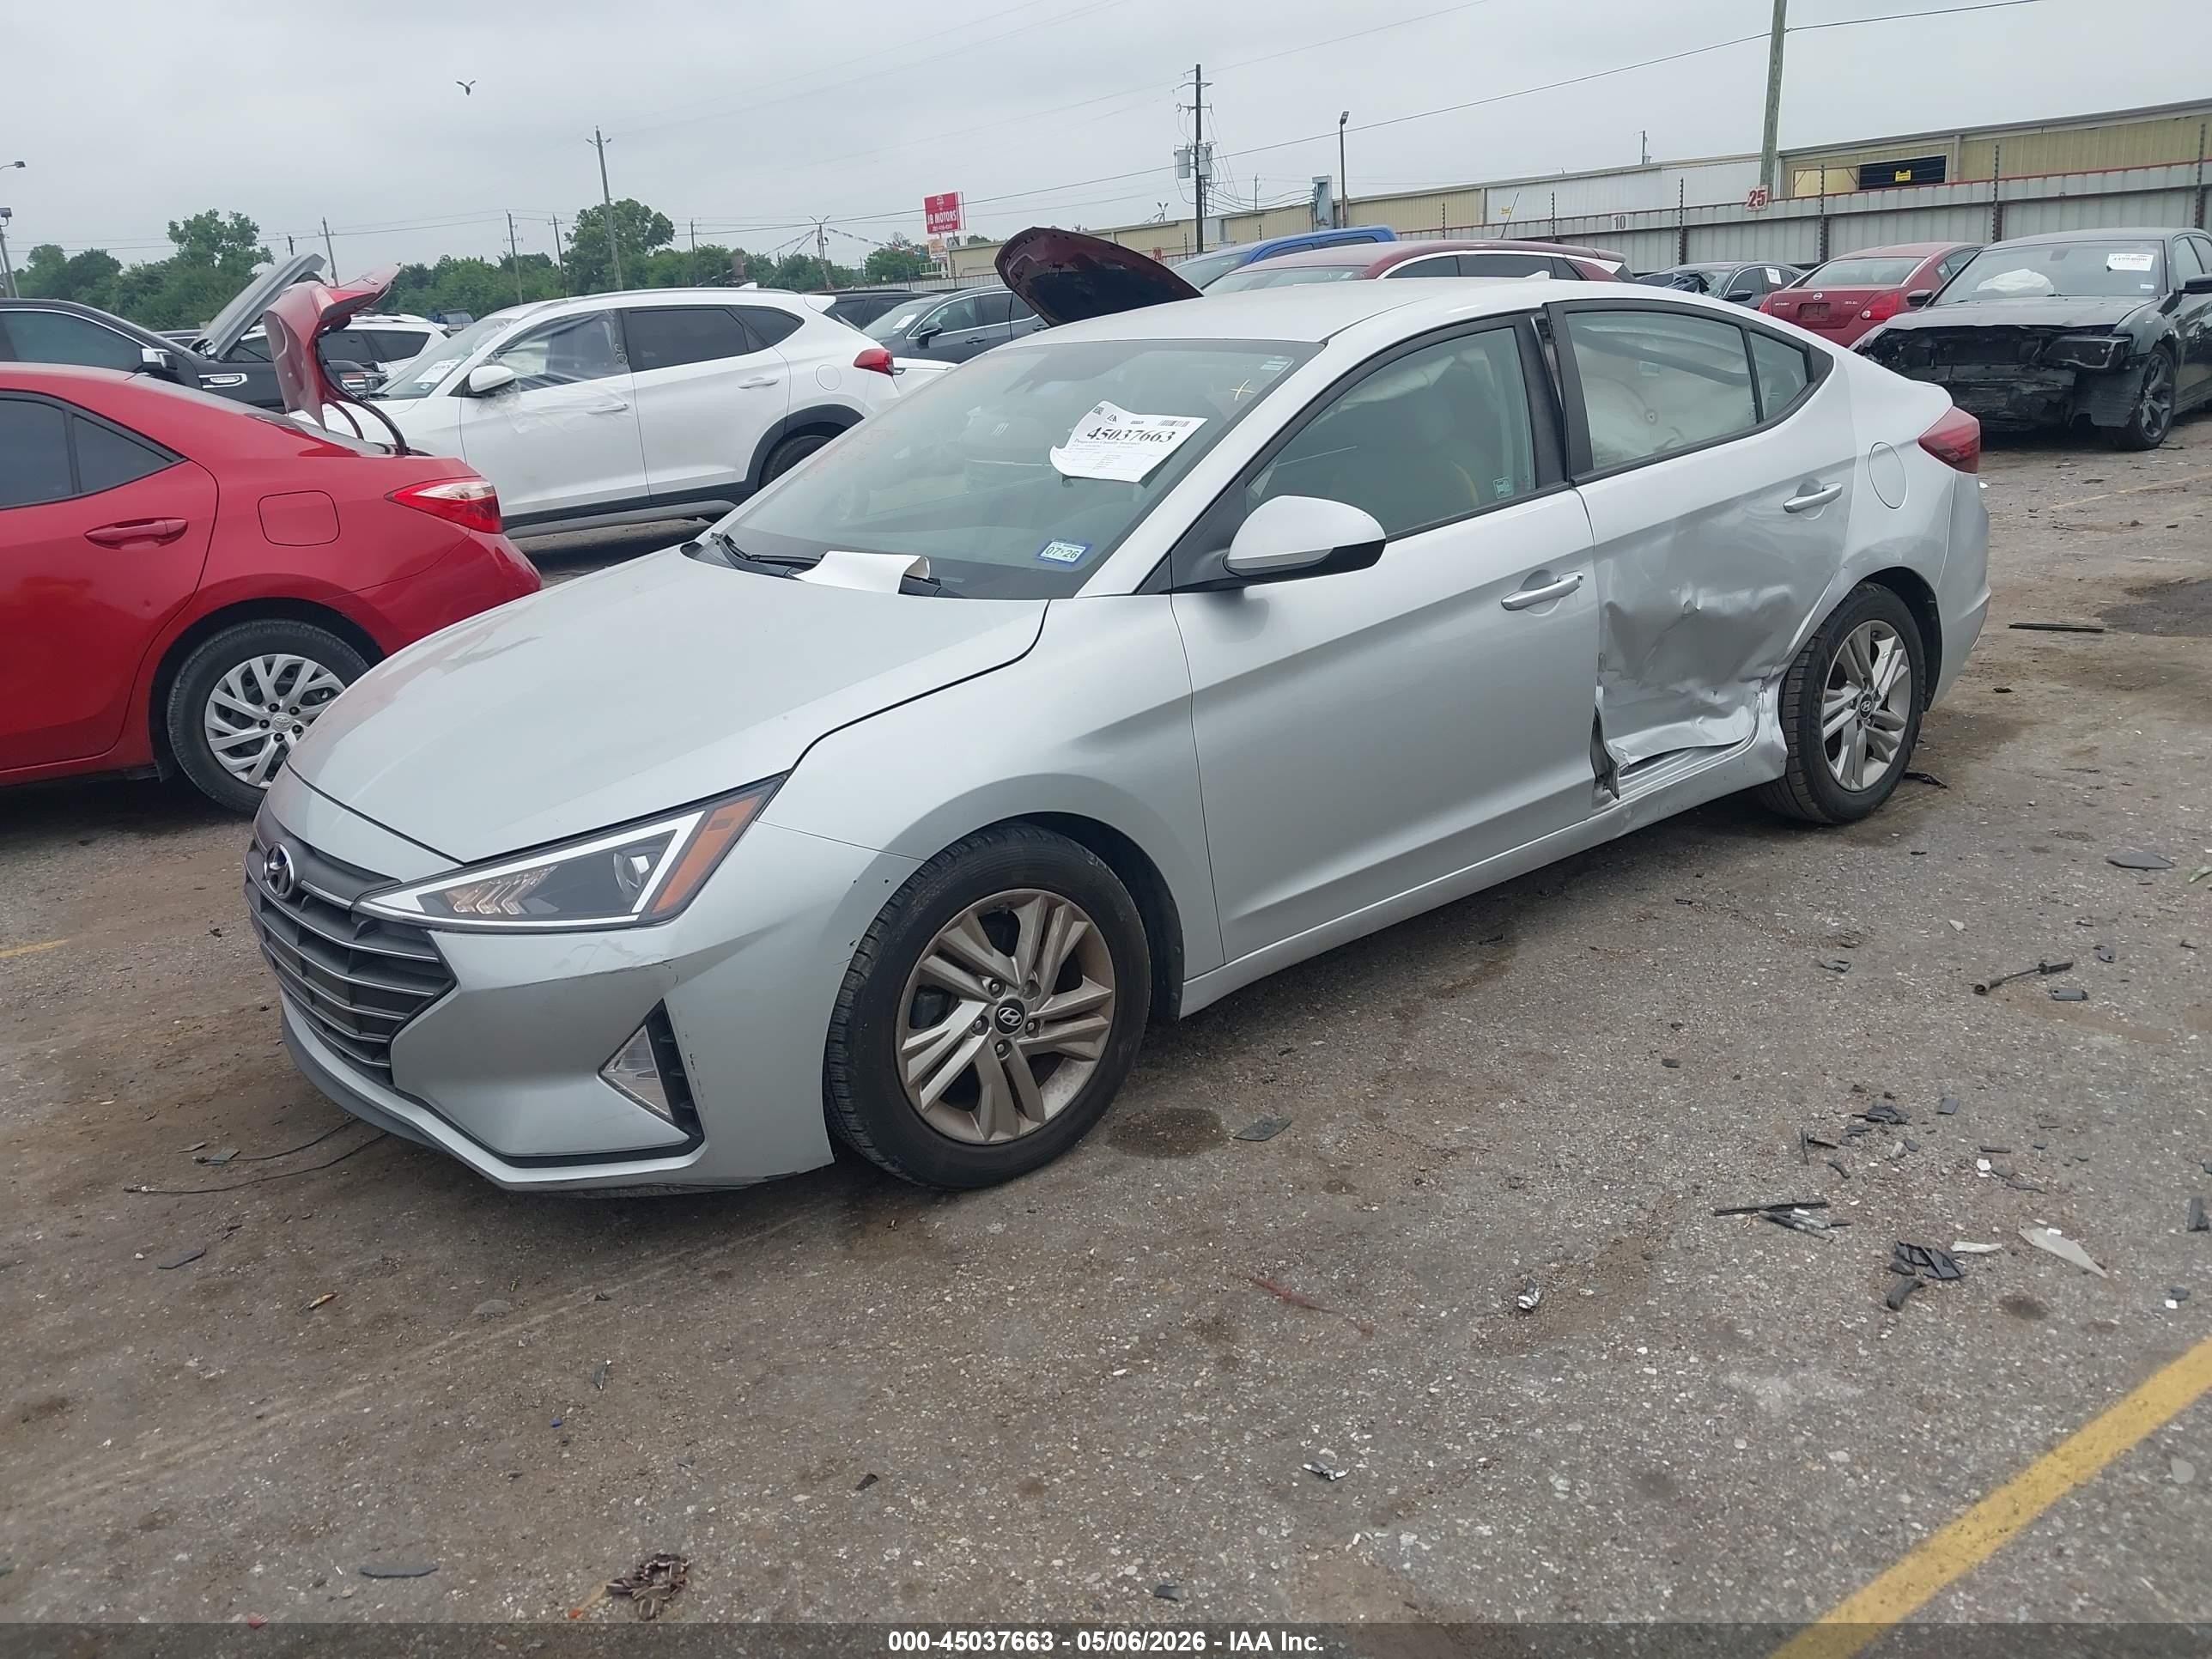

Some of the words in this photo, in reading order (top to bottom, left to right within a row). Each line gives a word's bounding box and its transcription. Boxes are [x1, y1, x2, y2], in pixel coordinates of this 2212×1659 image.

[1748, 190, 1765, 207] 25
[934, 210, 957, 224] MOTORS
[1613, 215, 1626, 229] 10
[1152, 248, 1162, 261] 20
[1087, 427, 1176, 442] 45037663
[1045, 546, 1061, 556] 07
[1062, 549, 1079, 558] 26
